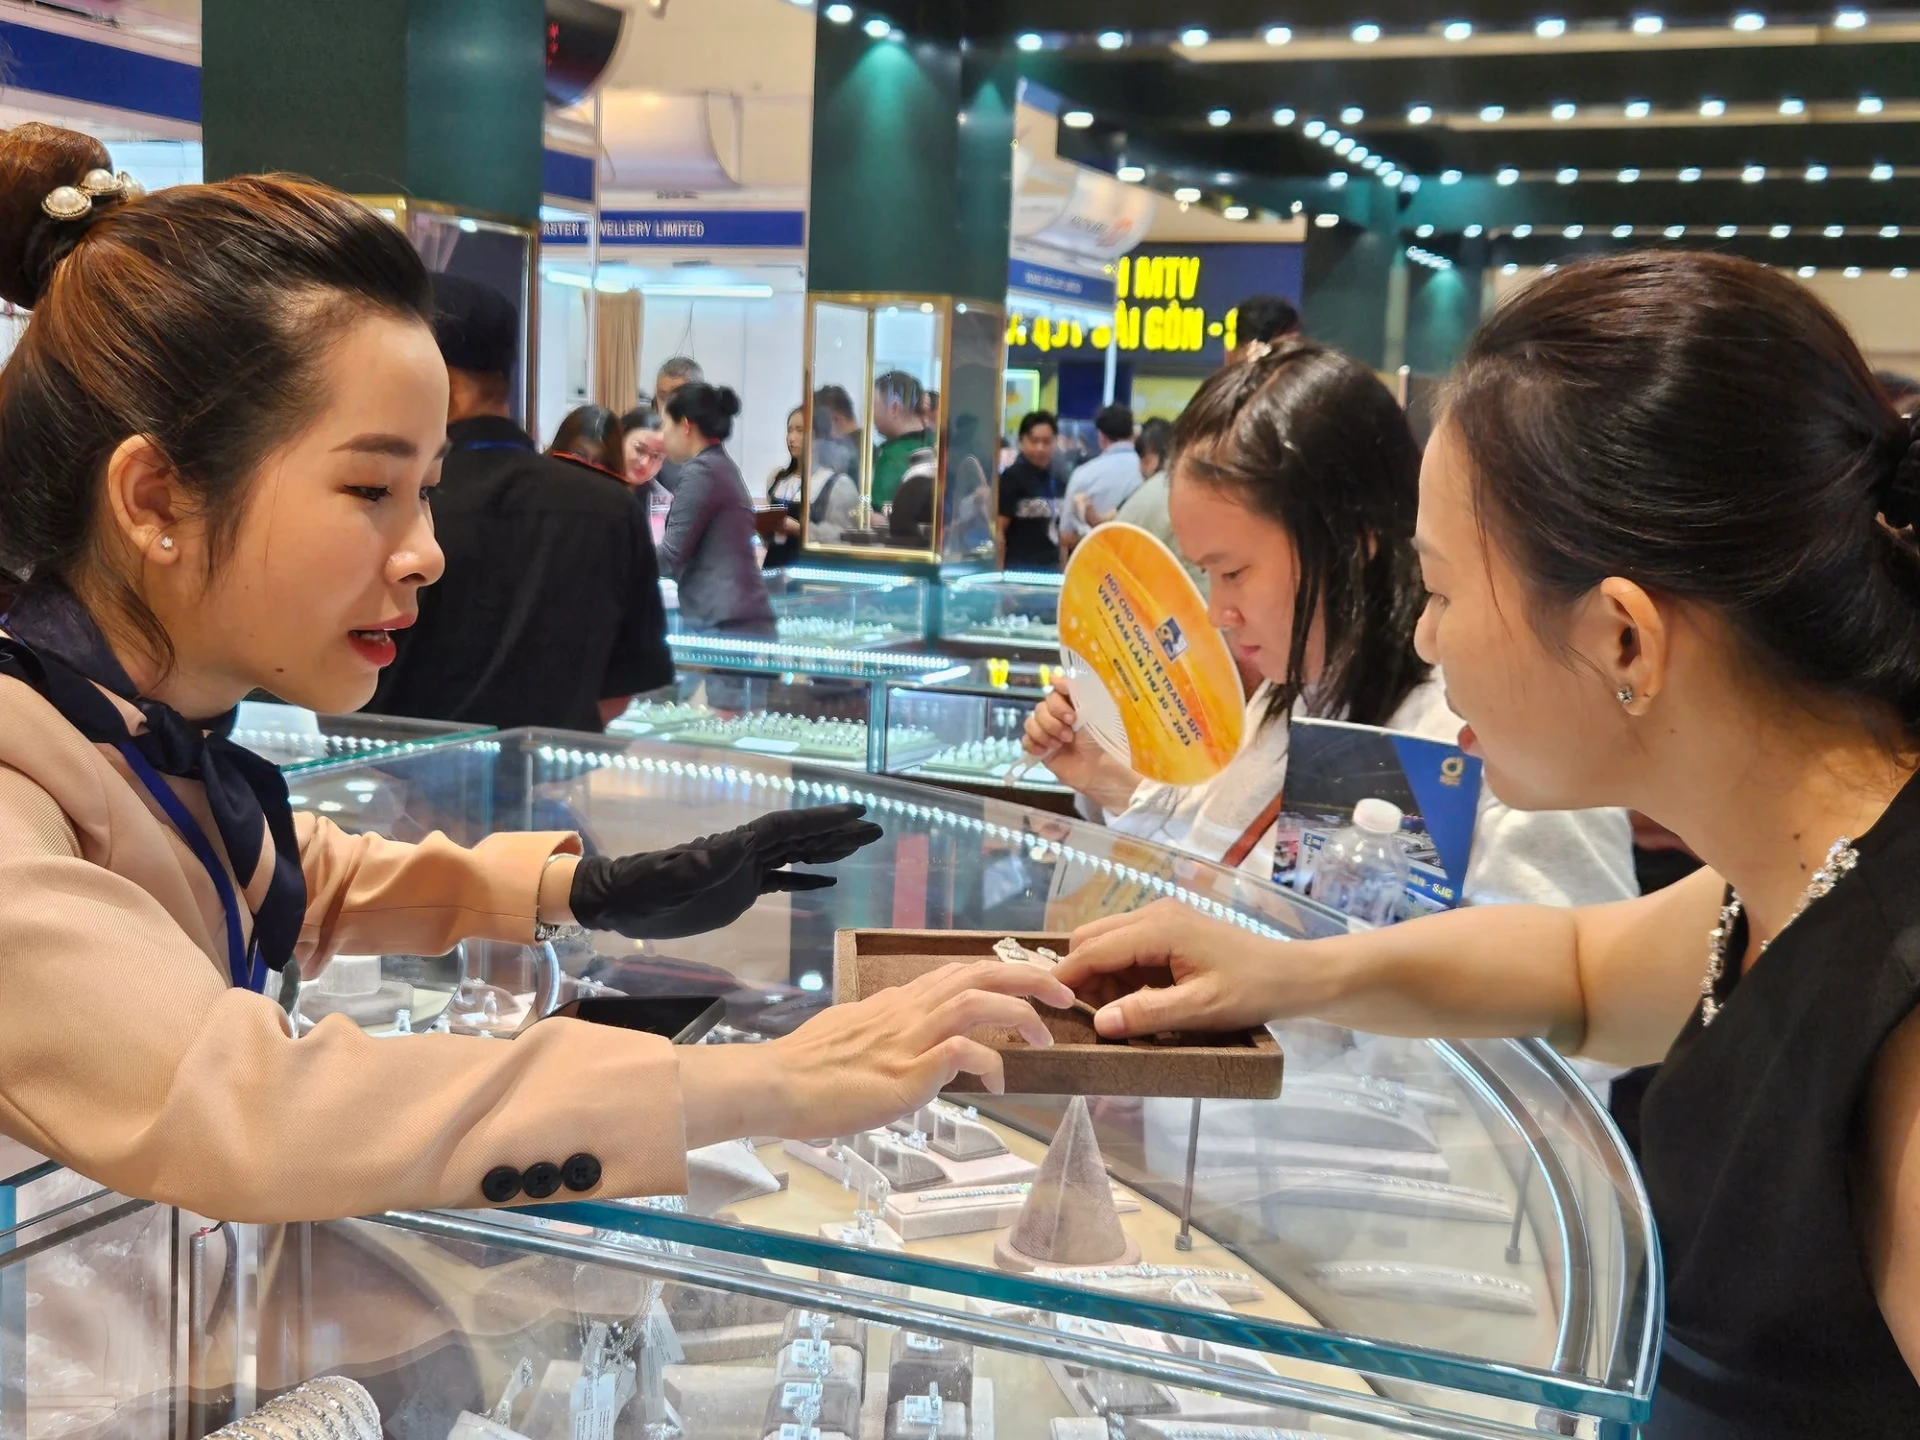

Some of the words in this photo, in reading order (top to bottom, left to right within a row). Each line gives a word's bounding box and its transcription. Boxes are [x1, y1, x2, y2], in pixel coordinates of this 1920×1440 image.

[541, 221, 580, 237] ASTER
[583, 220, 652, 237] JWELLERY
[655, 220, 705, 237] LIMITED
[1134, 256, 1200, 300] MTV
[1113, 614, 1131, 641] NAM
[1162, 675, 1188, 717] TRANG
